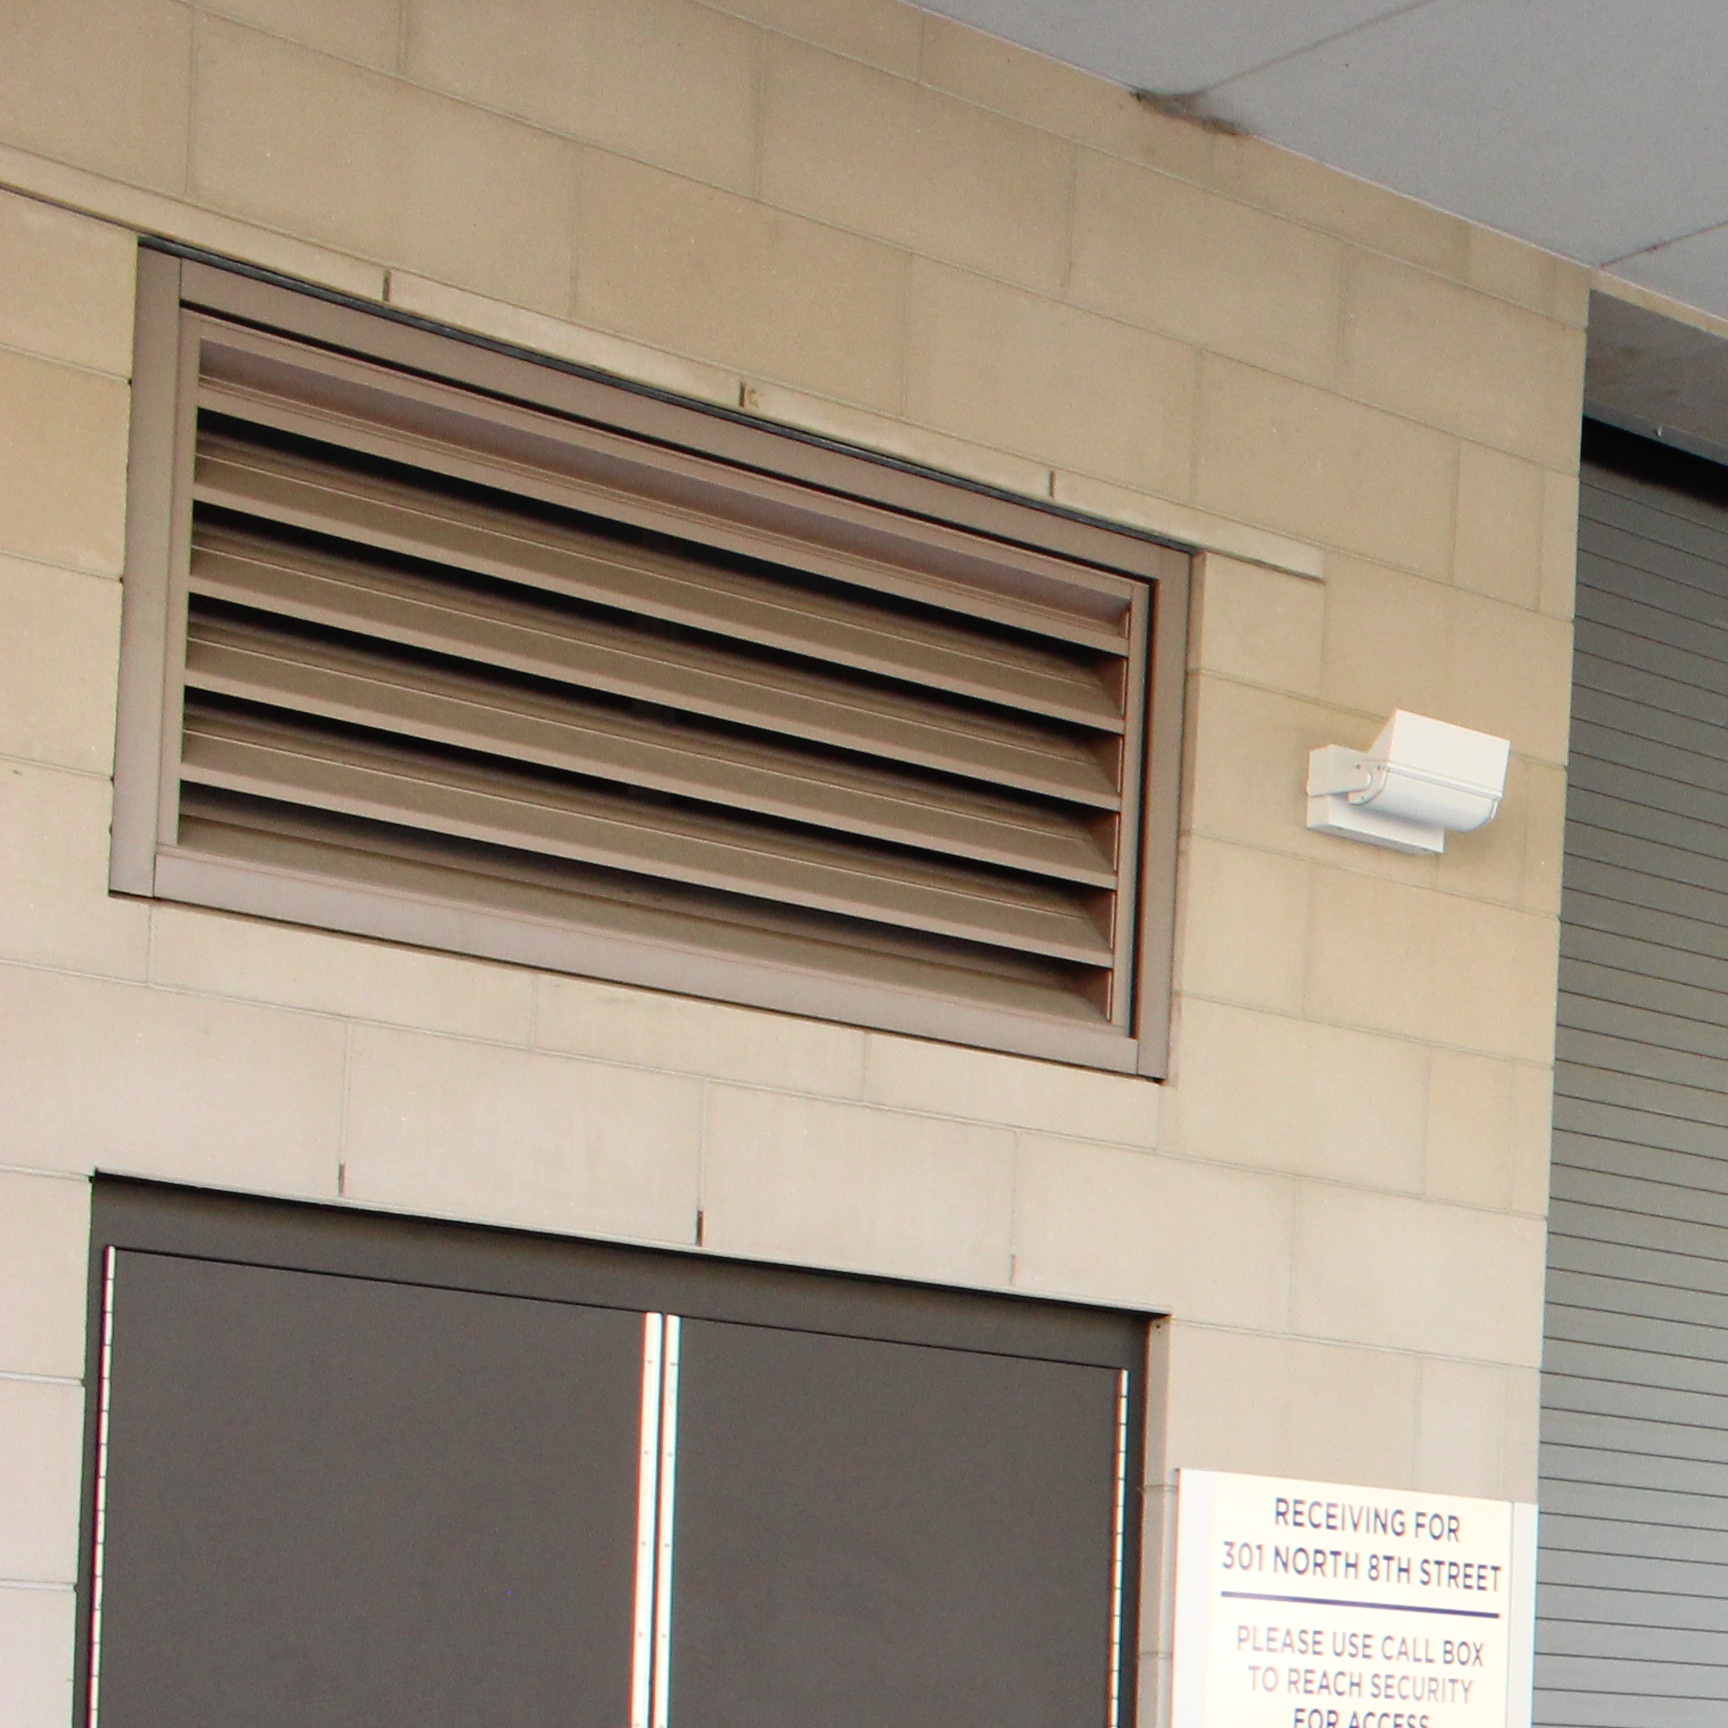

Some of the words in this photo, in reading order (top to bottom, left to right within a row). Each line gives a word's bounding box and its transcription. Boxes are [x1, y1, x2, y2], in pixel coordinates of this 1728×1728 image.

[1275, 1497, 1406, 1537] RECEIVING
[1414, 1511, 1461, 1542] FOR
[1222, 1541, 1263, 1572] 301
[1274, 1546, 1358, 1581] NORTH
[1368, 1553, 1410, 1585] 8TH
[1419, 1558, 1502, 1592] STREET
[1237, 1624, 1323, 1657] PLEASE
[1332, 1632, 1372, 1659] USE
[1382, 1635, 1434, 1664] CALL
[1443, 1639, 1484, 1668] BOX
[1248, 1665, 1278, 1692] TO
[1287, 1667, 1361, 1698] REACH
[1370, 1672, 1473, 1704] SECURITY
